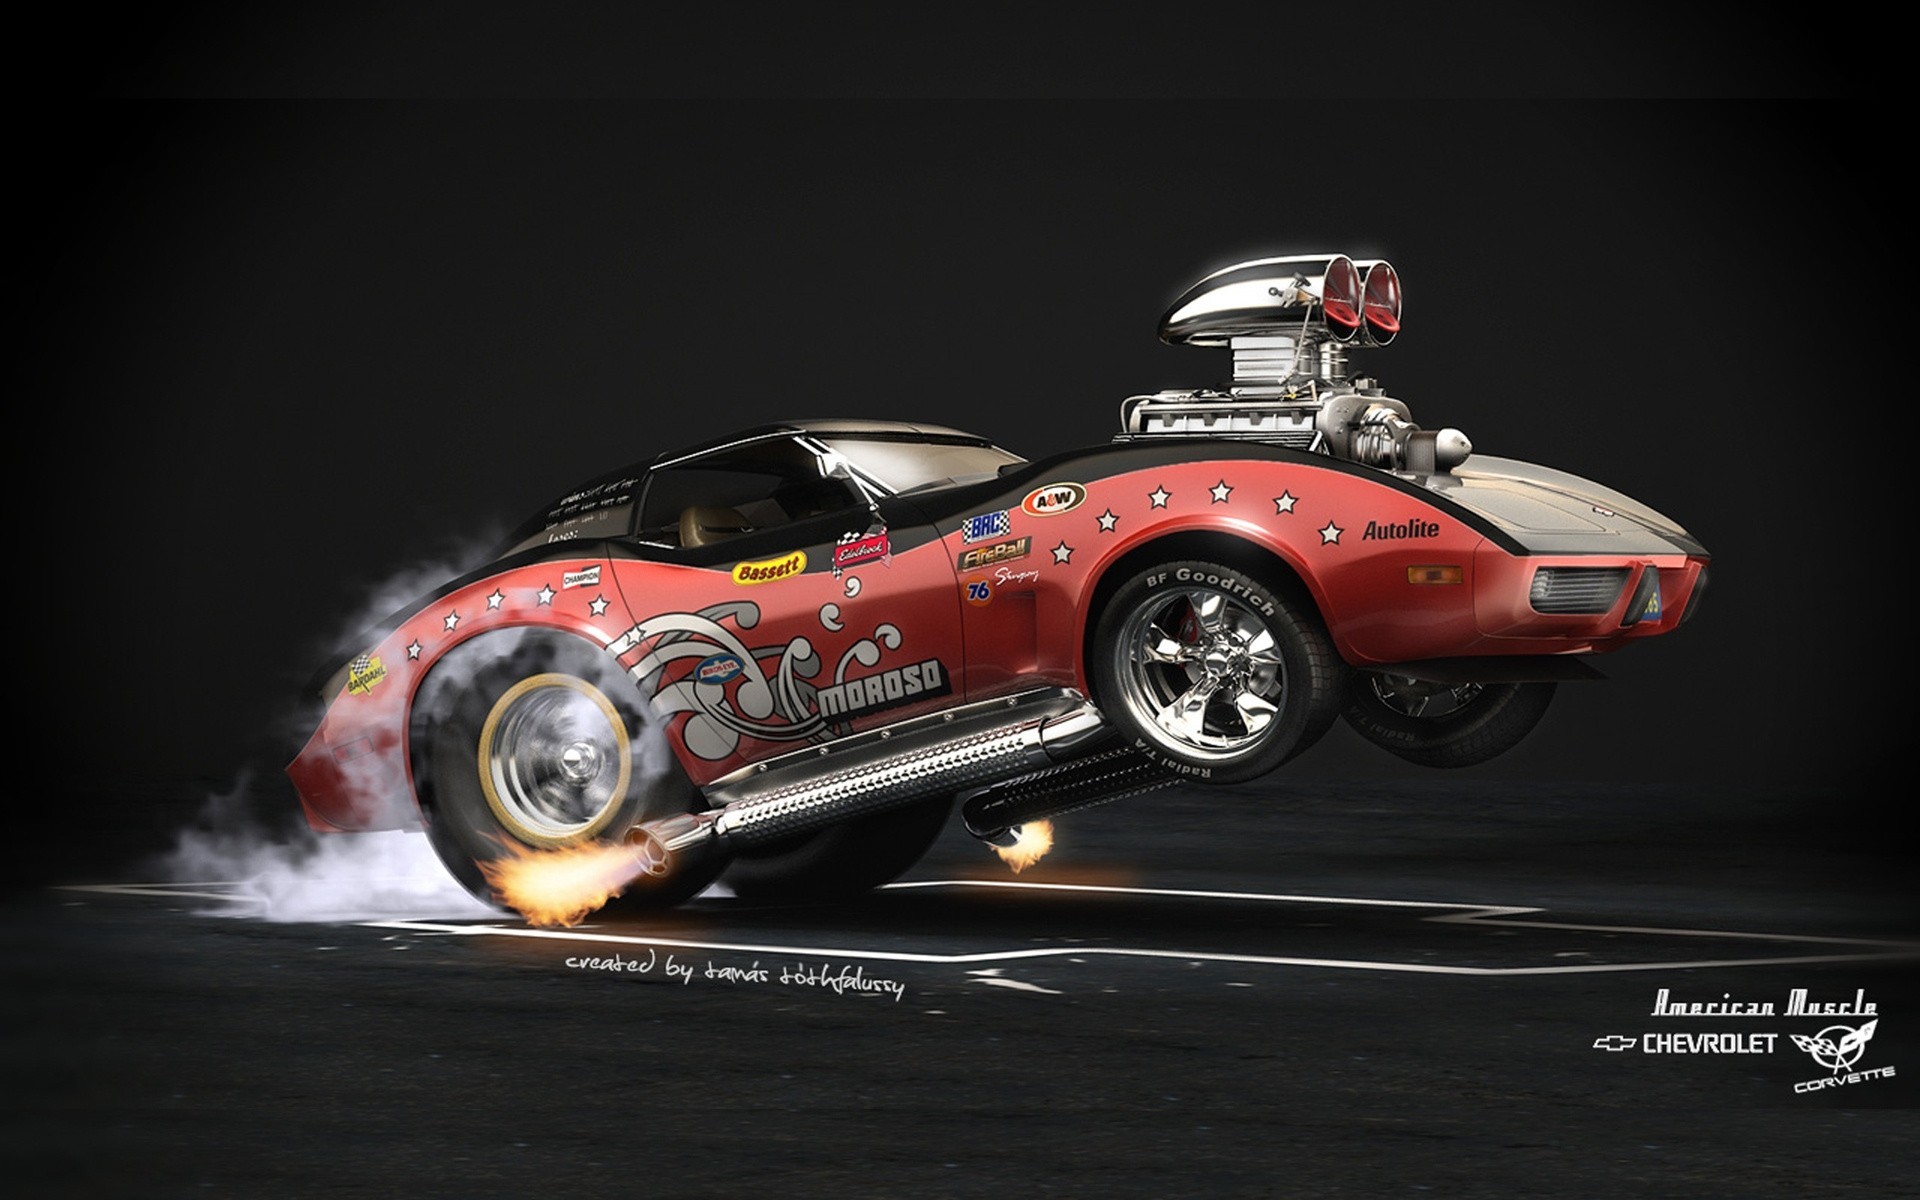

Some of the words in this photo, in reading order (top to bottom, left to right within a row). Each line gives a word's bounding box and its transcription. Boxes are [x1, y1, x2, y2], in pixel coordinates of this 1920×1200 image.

[1037, 491, 1072, 509] A&W
[1362, 518, 1440, 541] Autolite
[839, 541, 883, 562] Edelbrock
[563, 572, 599, 585] CHAMPION
[738, 556, 800, 581] Bassett
[968, 581, 990, 601] 76
[1146, 572, 1168, 588] BF
[1175, 567, 1276, 617] Goodrich
[817, 659, 942, 718] MOROSO
[1134, 737, 1156, 761] T/A
[1161, 757, 1212, 779] Radial
